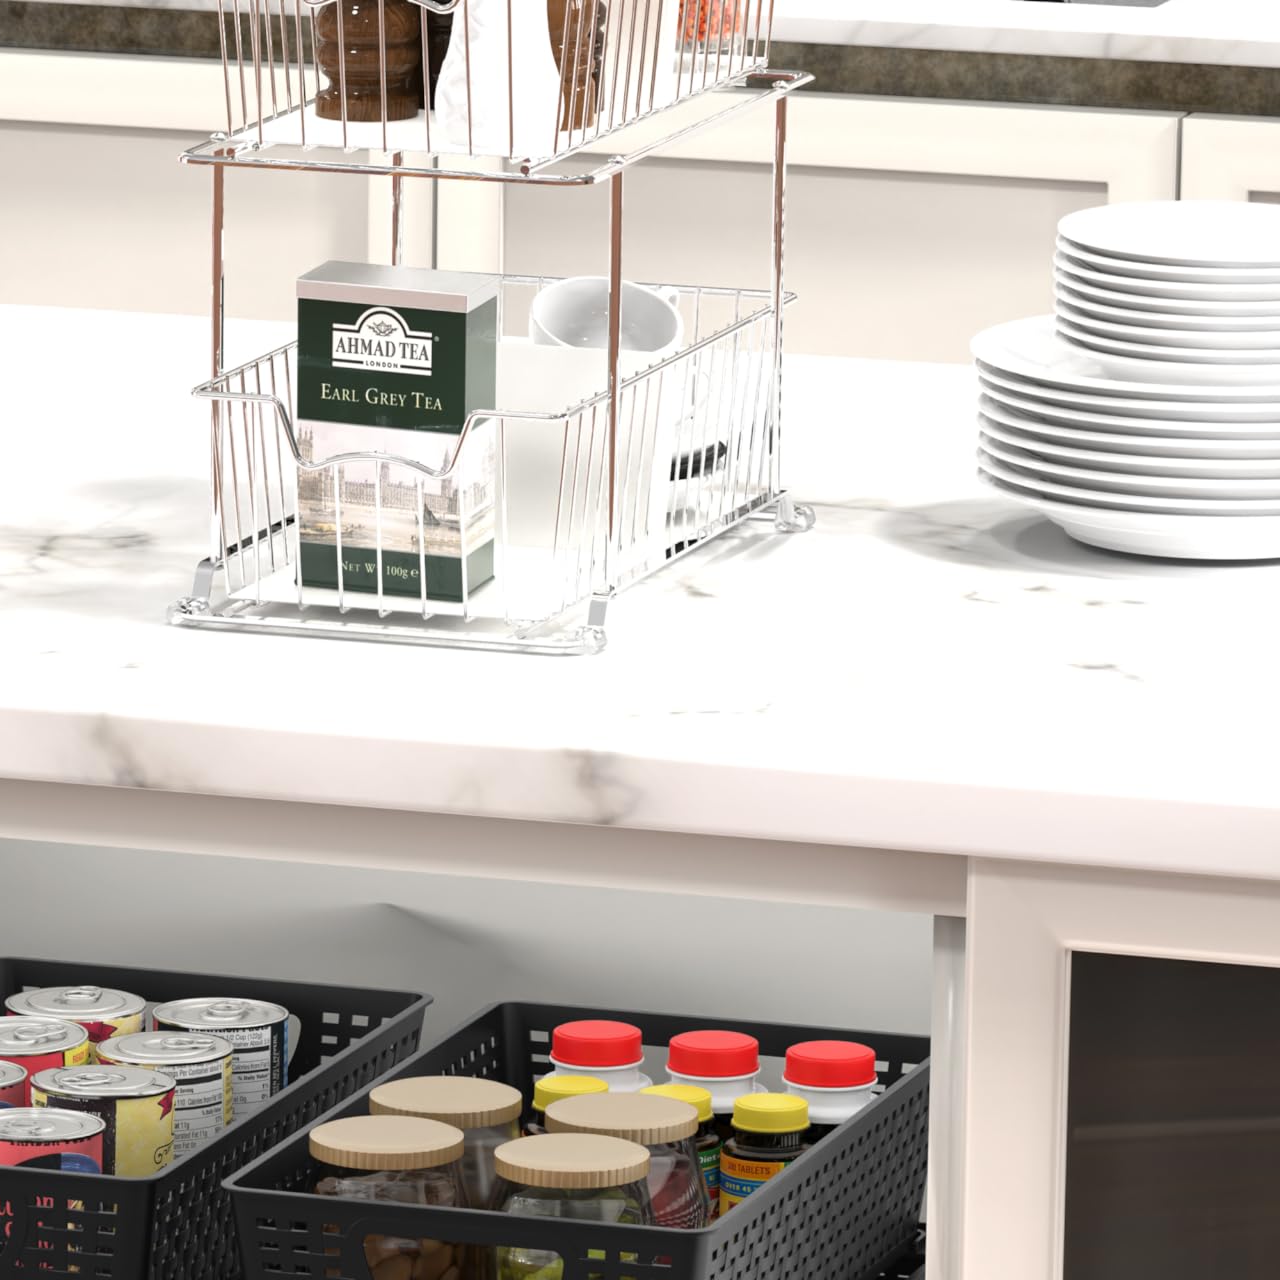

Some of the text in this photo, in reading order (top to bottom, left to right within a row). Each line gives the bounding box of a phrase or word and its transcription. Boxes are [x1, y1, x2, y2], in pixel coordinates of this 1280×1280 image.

[335, 337, 430, 362] AHMAD TEA
[365, 360, 399, 369] LONDON
[386, 565, 408, 578] 100g
